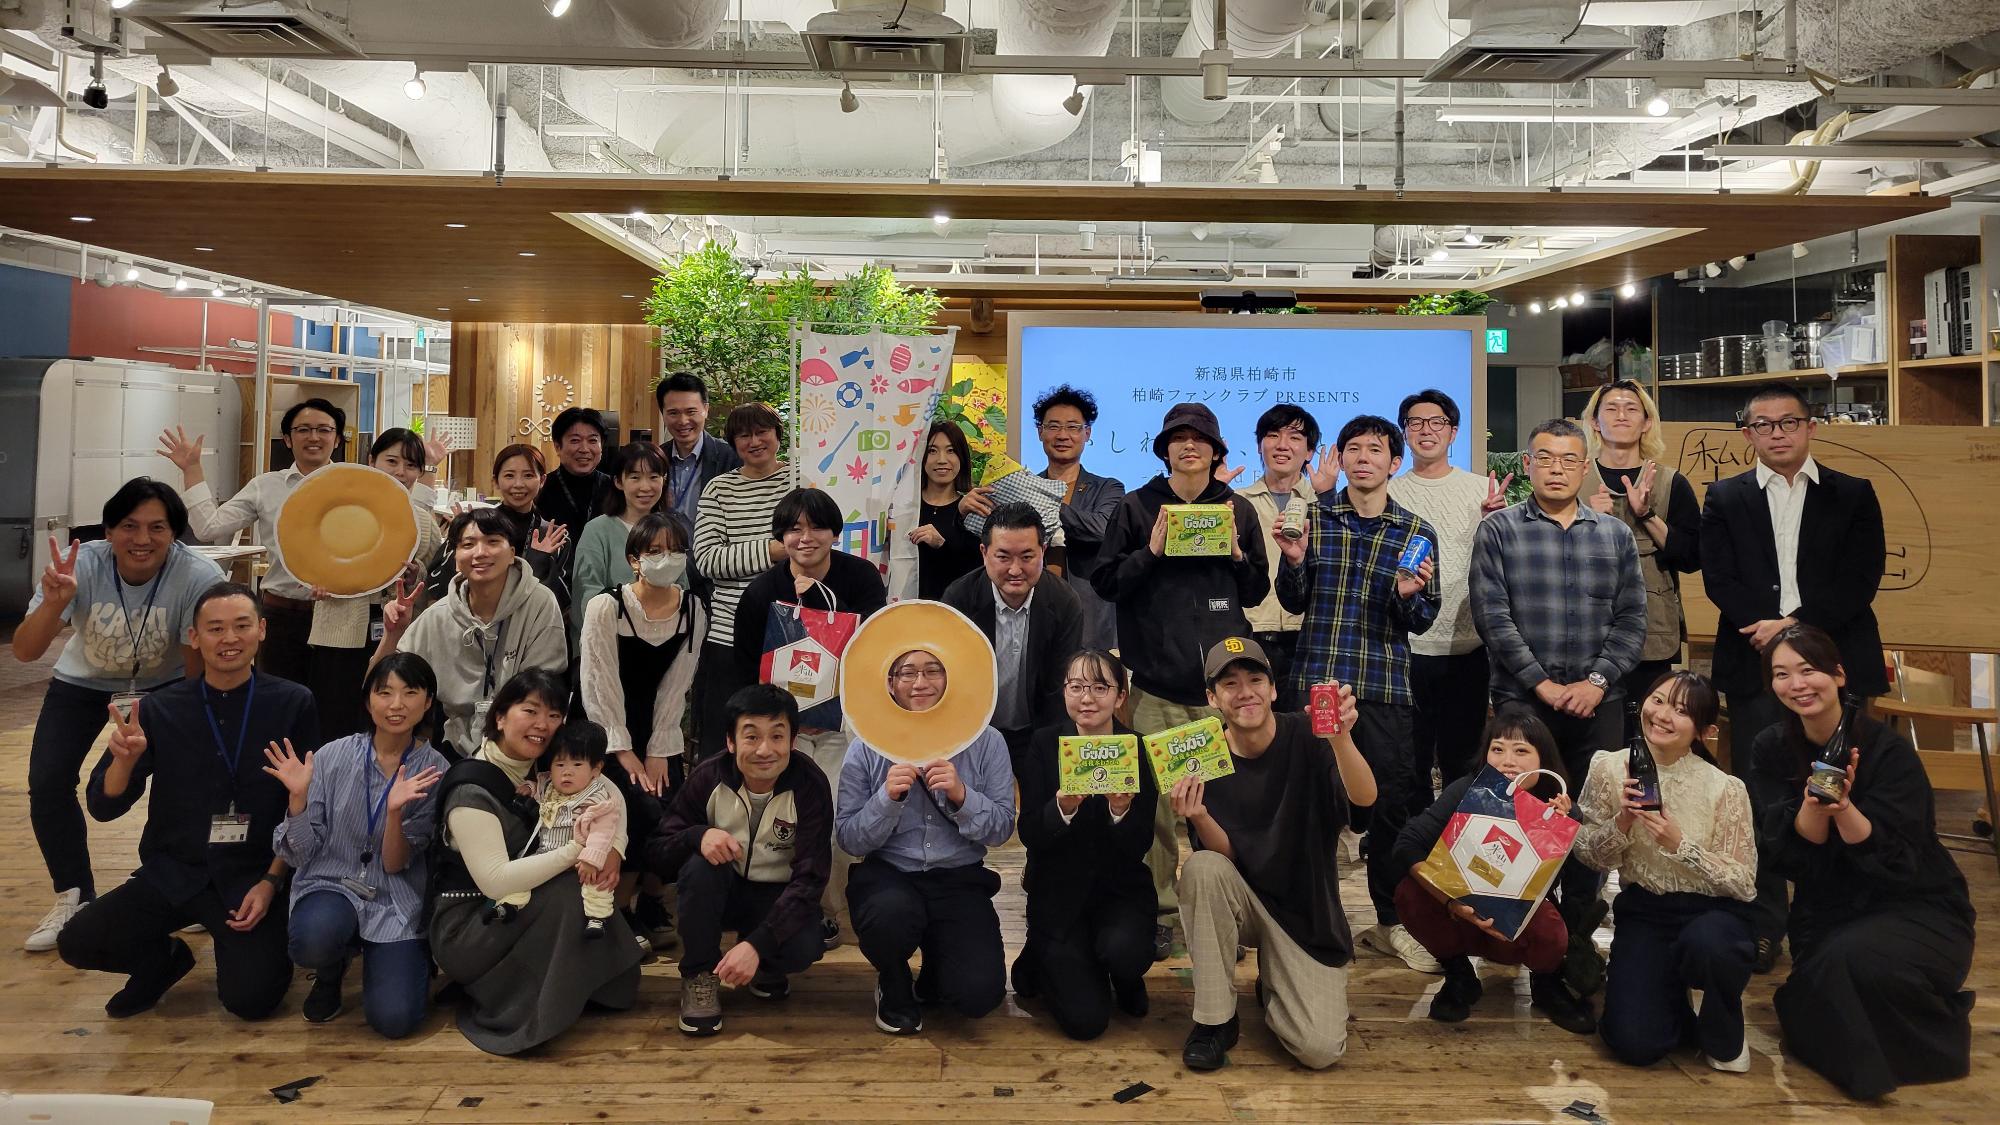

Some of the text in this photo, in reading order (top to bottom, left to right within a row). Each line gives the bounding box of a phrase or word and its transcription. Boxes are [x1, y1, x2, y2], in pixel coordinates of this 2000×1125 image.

[1194, 366, 1297, 382] 新潟県柏崎市
[1132, 387, 1360, 404] 柏崎ファンクラブ PRESENTS
[1079, 742, 1120, 760] ピッカラ
[1167, 733, 1207, 755] ピッカラ
